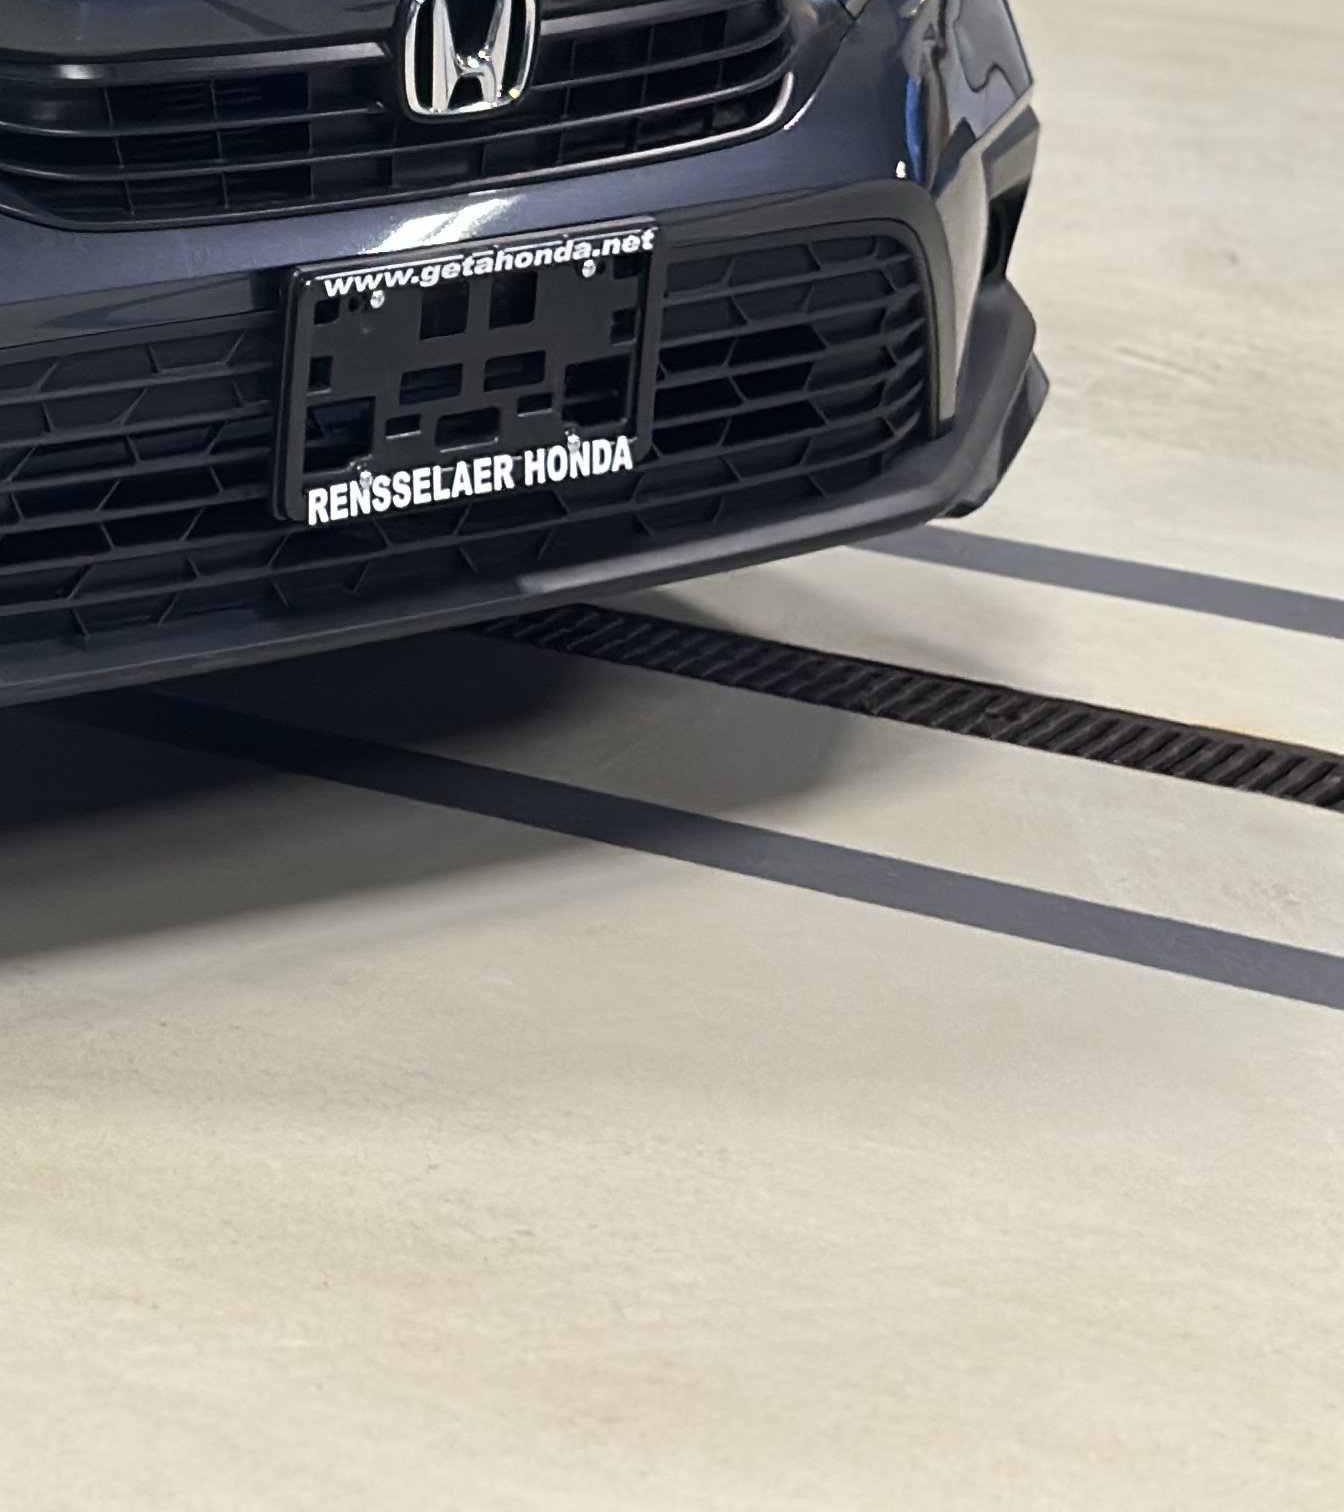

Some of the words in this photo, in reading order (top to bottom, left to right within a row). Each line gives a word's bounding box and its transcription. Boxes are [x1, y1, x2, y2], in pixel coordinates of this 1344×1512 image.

[324, 231, 655, 297] www.getahonda.net
[308, 454, 515, 526] RENSSELAER
[524, 435, 633, 486] HONDA
